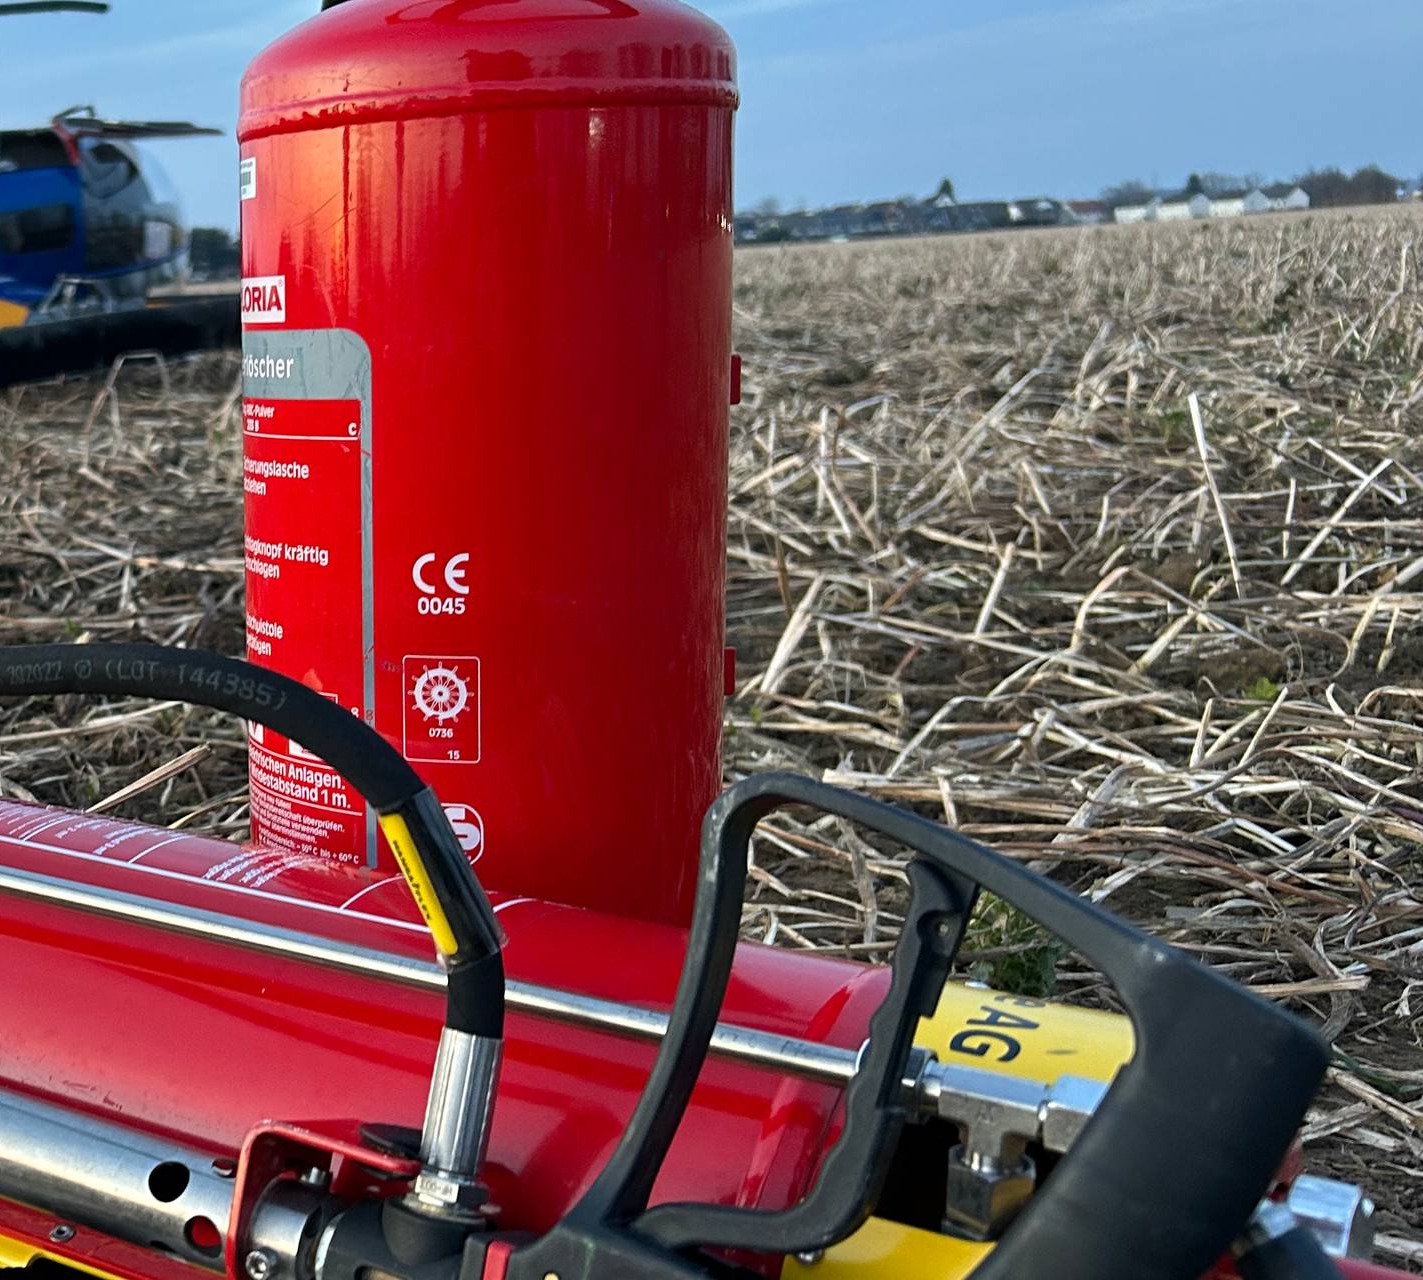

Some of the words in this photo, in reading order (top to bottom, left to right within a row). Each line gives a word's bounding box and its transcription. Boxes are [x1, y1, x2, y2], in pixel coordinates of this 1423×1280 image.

[242, 286, 282, 312] ORIA
[348, 422, 357, 436] C
[284, 544, 329, 566] kräftig
[412, 552, 470, 594] CE
[417, 597, 466, 615] 0045
[429, 728, 453, 738] 0736
[447, 750, 460, 760] 15
[288, 763, 346, 790] Anlagen.
[321, 789, 328, 804] 1
[332, 793, 351, 808] m.
[302, 814, 345, 832] überprüfen.
[949, 1005, 1040, 1062] AG
